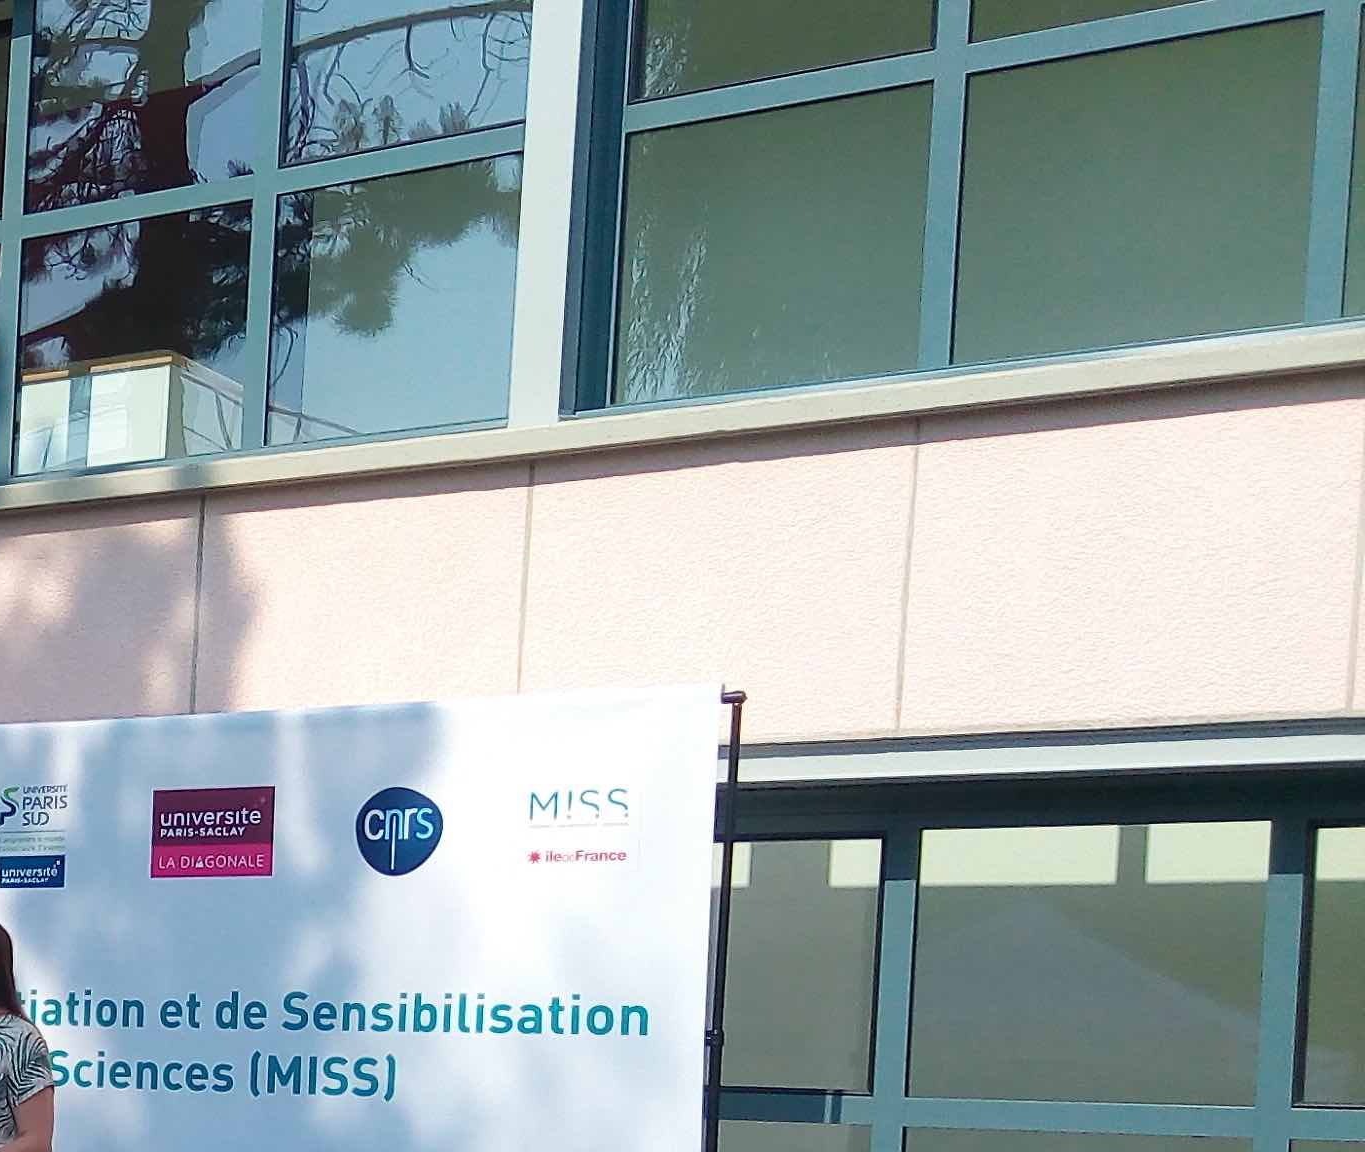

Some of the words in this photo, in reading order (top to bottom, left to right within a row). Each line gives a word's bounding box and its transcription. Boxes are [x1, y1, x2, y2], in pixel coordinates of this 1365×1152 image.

[22, 795, 69, 810] PARIS
[21, 811, 50, 827] SUD
[160, 826, 247, 838] PARIS-SACLAY
[158, 855, 175, 869] LA
[180, 853, 265, 869] DIAGONALE
[159, 992, 201, 1030] et
[214, 991, 268, 1031] de
[281, 991, 650, 1037] Sensibilisation
[49, 1049, 235, 1093] Sciences
[249, 1049, 397, 1103] (MISS)
